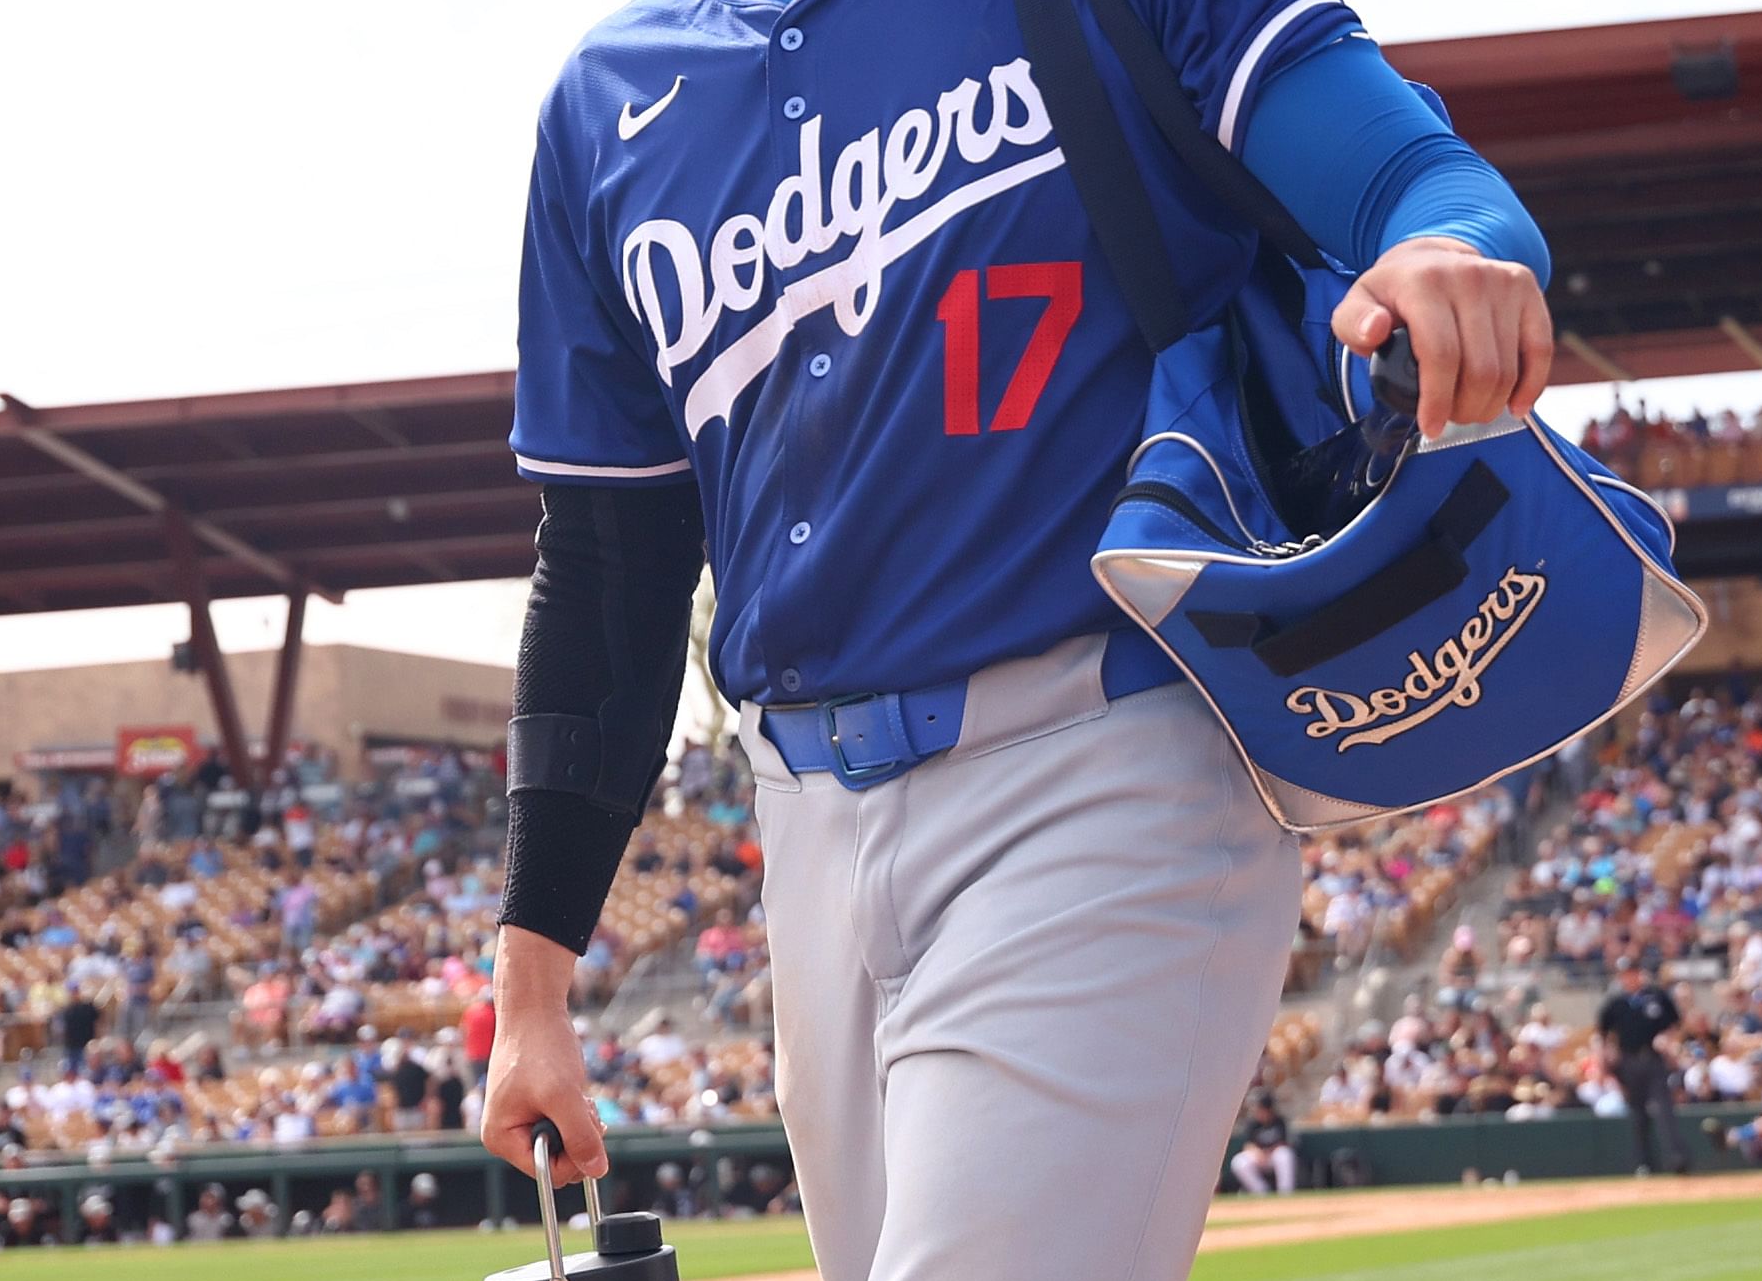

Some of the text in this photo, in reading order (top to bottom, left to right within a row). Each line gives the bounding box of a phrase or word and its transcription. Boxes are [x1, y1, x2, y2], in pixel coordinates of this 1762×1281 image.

[623, 57, 1067, 441] Dodgers
[936, 261, 1083, 435] 17
[1286, 566, 1546, 752] Dodgers
